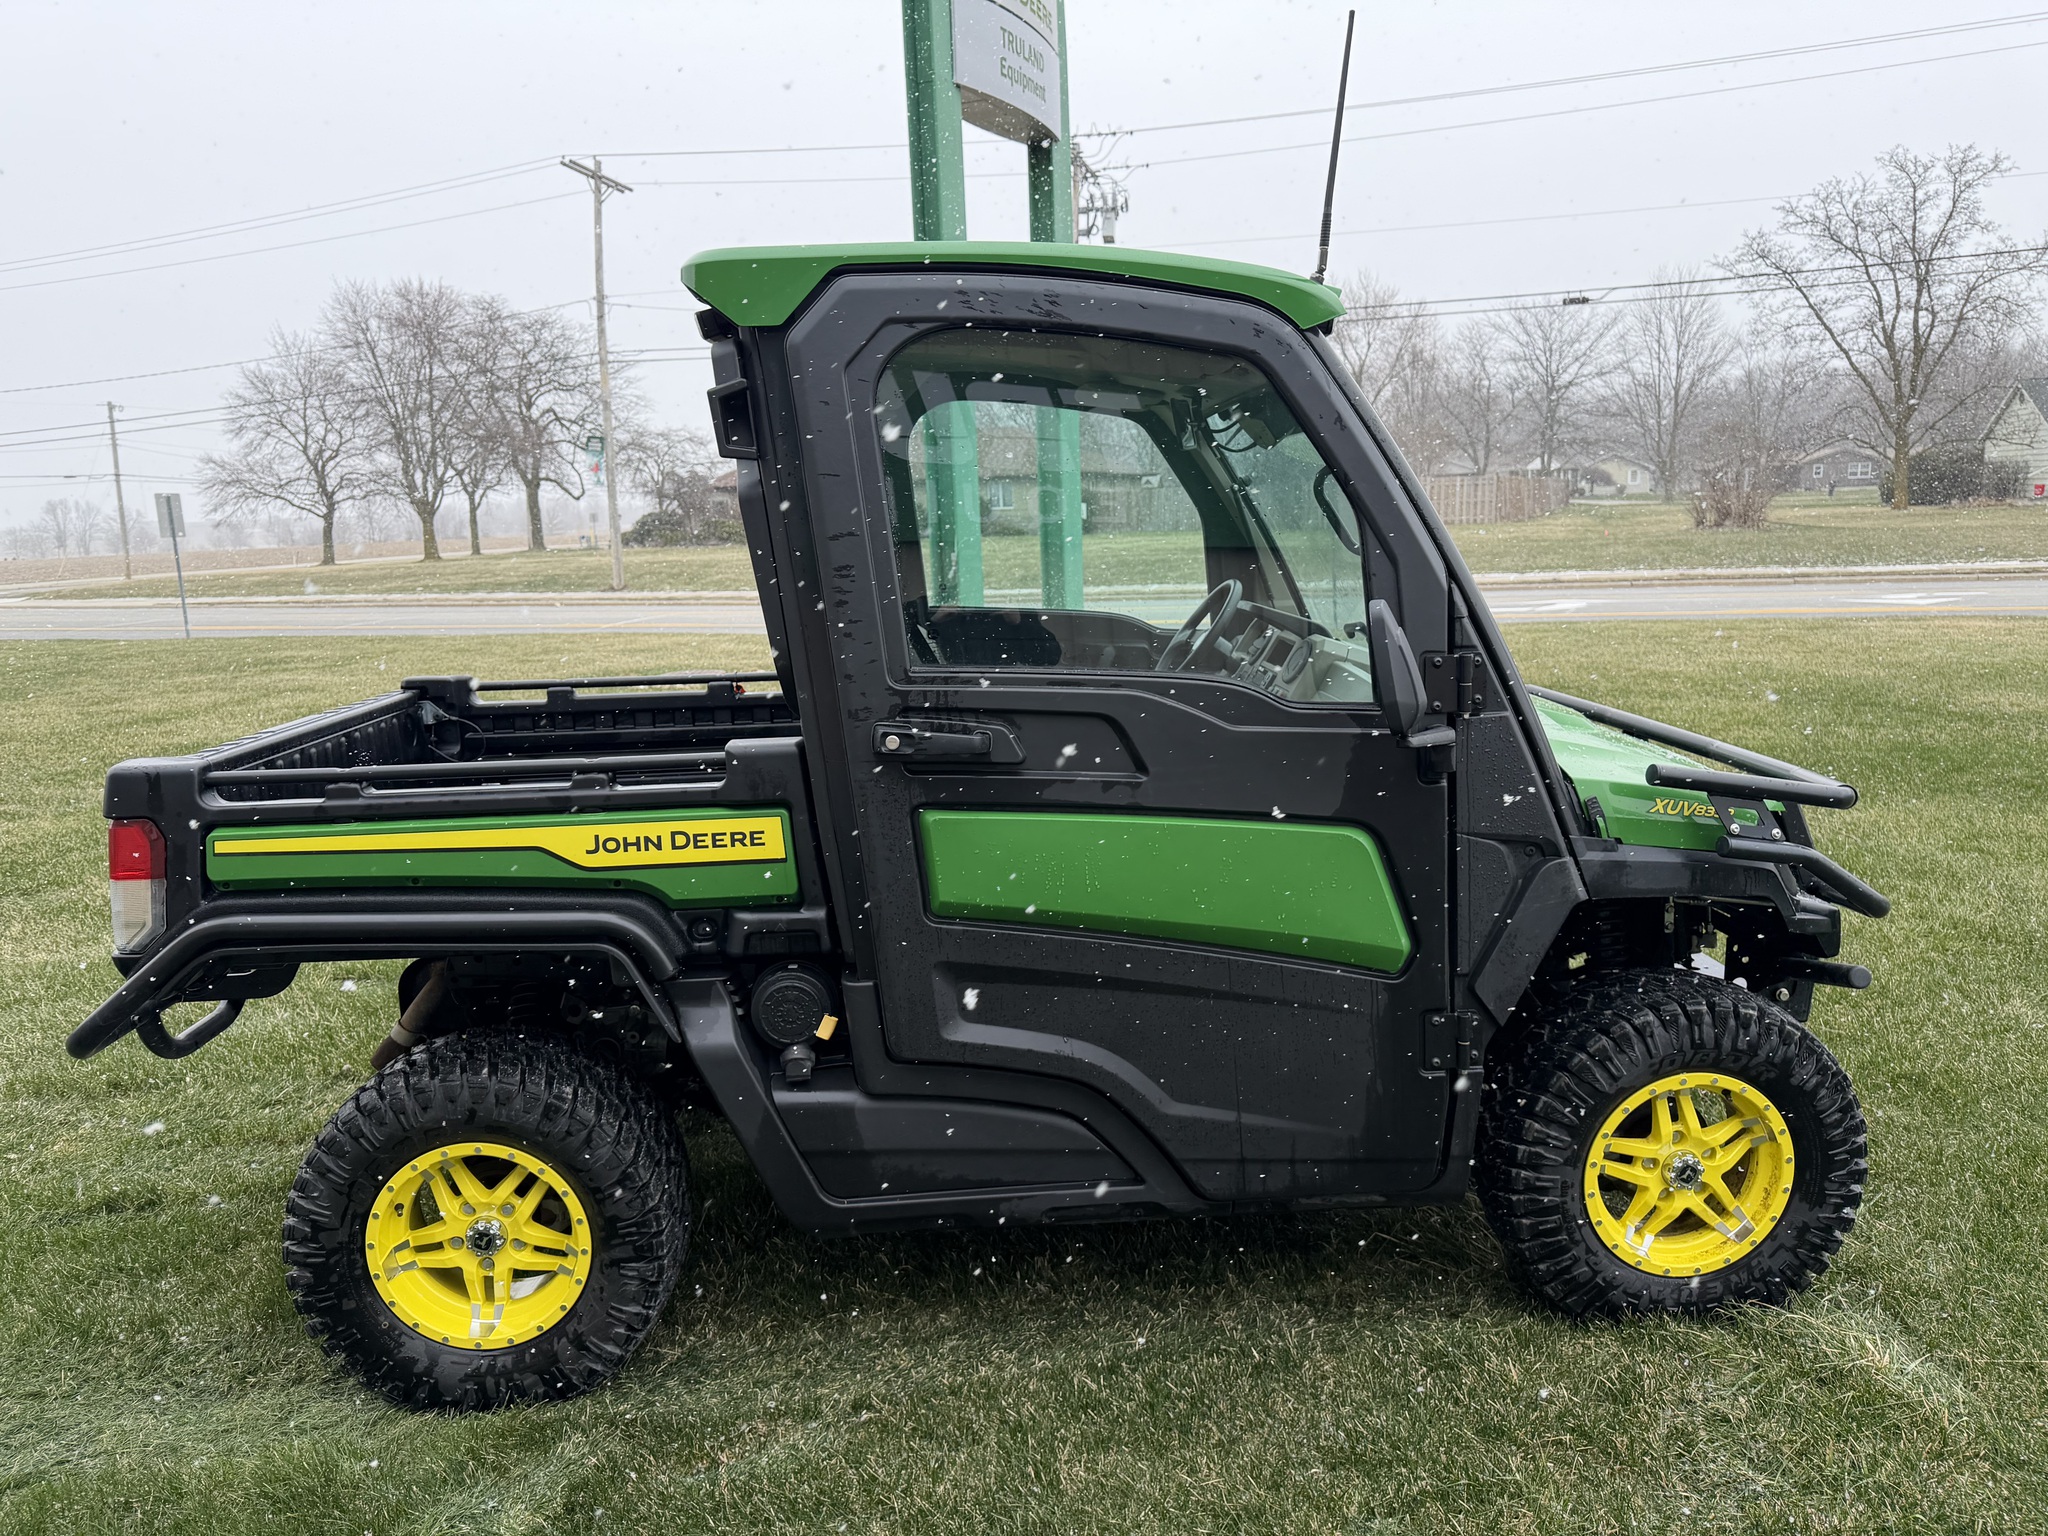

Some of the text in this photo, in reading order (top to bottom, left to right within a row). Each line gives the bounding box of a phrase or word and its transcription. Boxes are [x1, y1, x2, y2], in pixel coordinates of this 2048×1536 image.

[1001, 27, 1044, 73] TRULAND
[1001, 56, 1046, 103] Equipment
[1649, 798, 1734, 819] XUV83
[586, 830, 766, 855] JOHN DEERE
